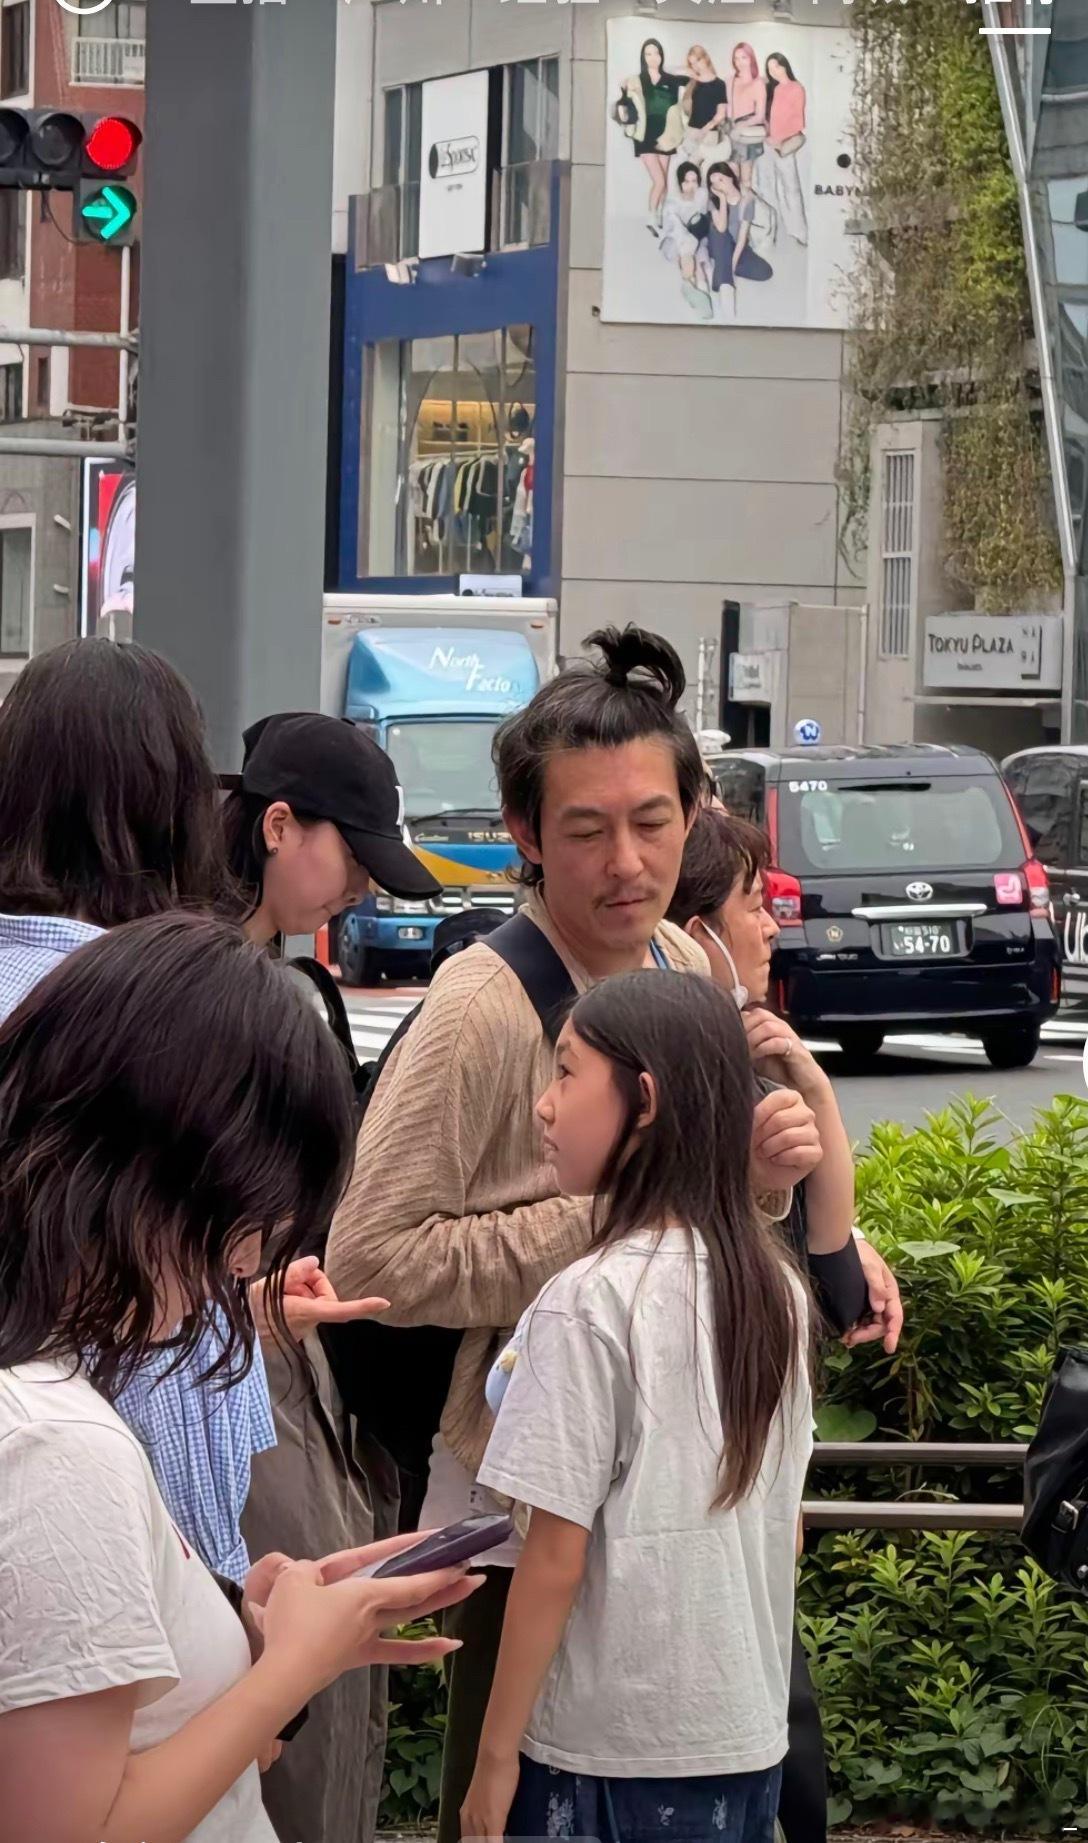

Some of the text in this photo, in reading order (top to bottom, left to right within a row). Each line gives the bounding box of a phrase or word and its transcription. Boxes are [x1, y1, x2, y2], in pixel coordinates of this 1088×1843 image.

[928, 633, 1014, 654] TOKYU PLAZA
[428, 646, 480, 669] North
[788, 780, 828, 792] 5470
[467, 831, 512, 843] ISUZ
[903, 935, 951, 954] 54-70
